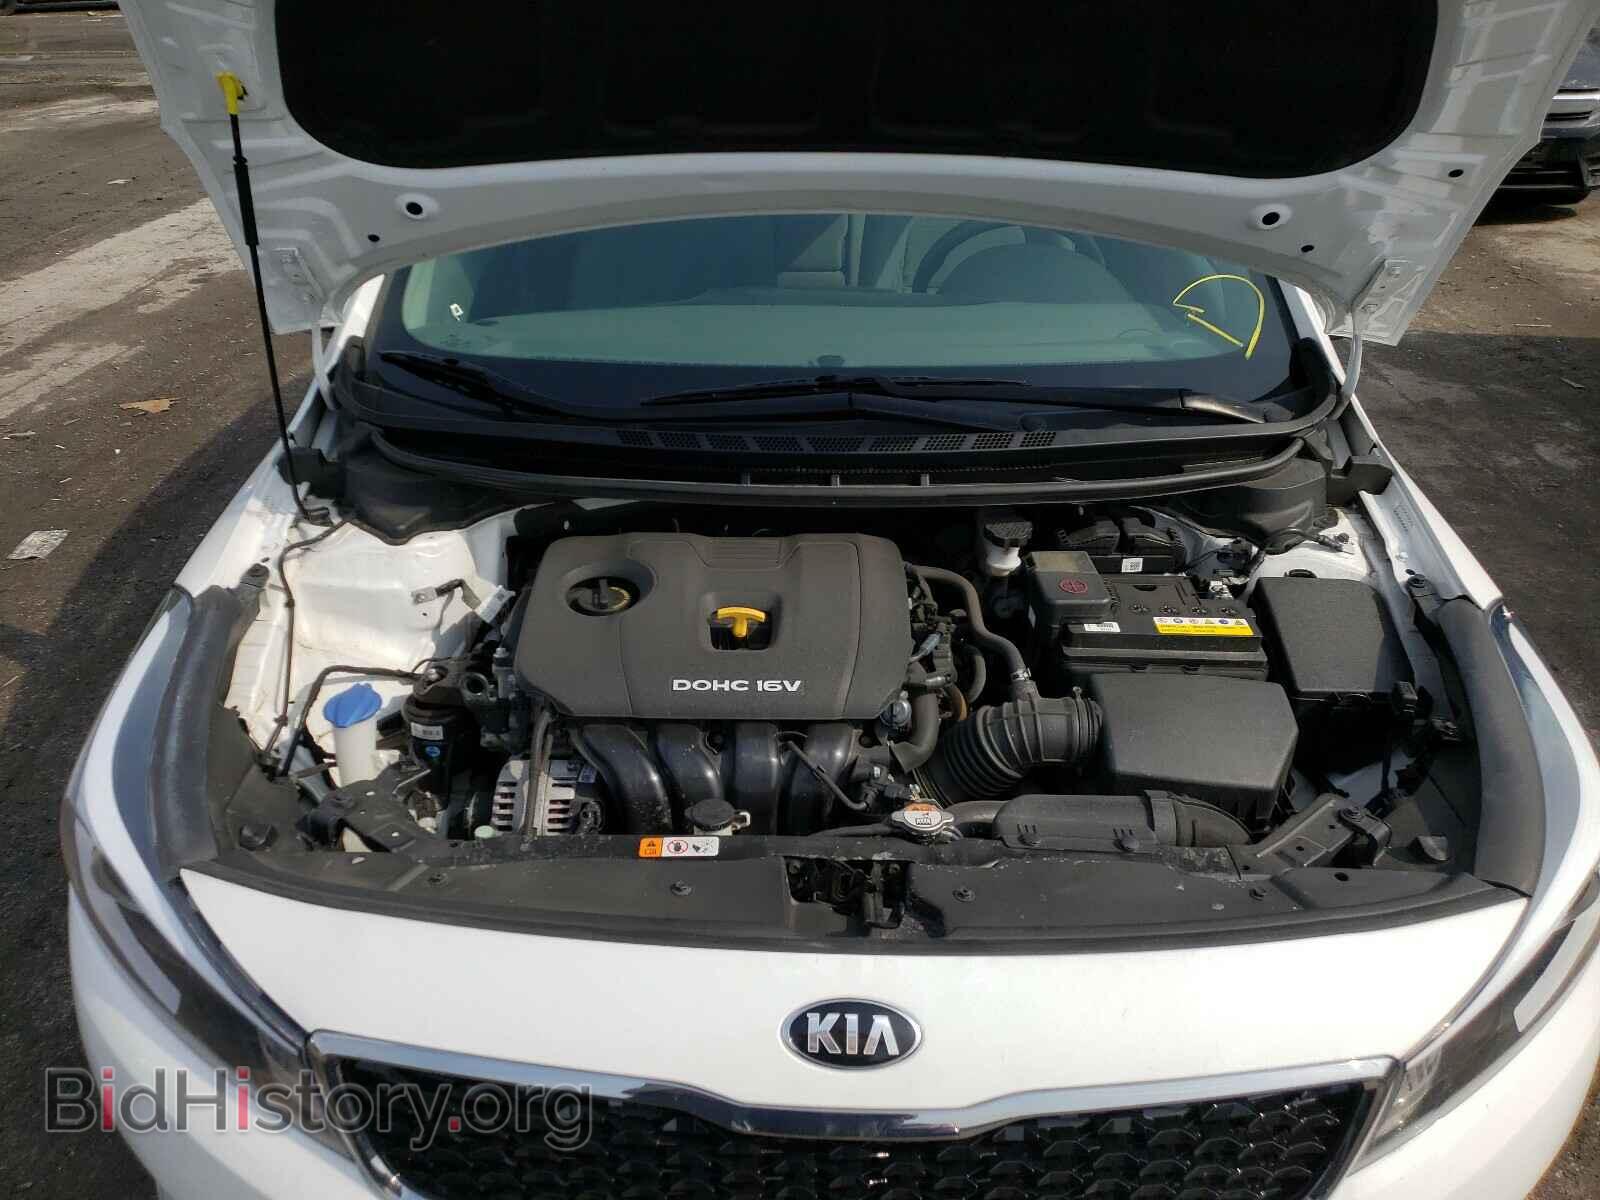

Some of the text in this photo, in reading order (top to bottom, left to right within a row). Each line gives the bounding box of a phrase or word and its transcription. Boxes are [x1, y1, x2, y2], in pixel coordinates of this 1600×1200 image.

[672, 679, 802, 692] DOHC 16V
[806, 1012, 900, 1056] KIA
